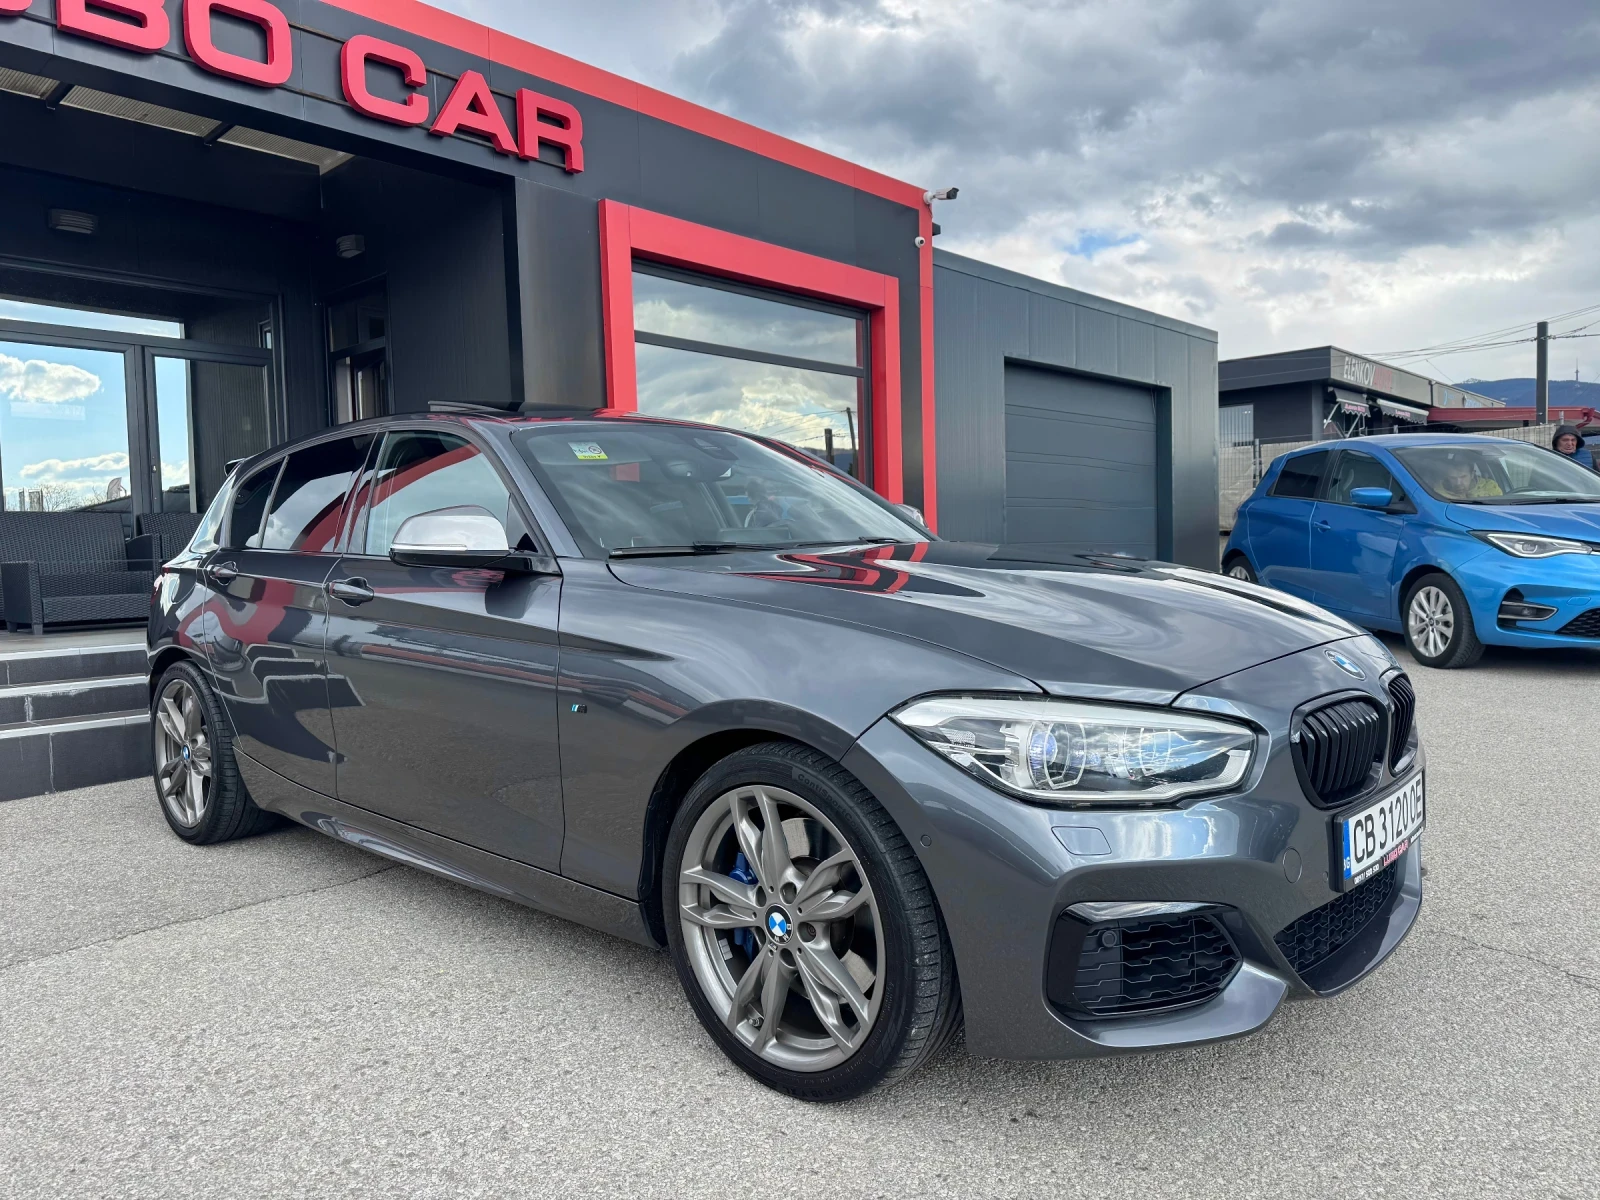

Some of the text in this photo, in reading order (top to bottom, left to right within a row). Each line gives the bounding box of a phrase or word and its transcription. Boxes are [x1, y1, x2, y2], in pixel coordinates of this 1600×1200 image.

[0, 0, 584, 174] BO CAR
[1343, 356, 1376, 387] ELENKOV
[1353, 778, 1422, 864] CB 3120 OE
